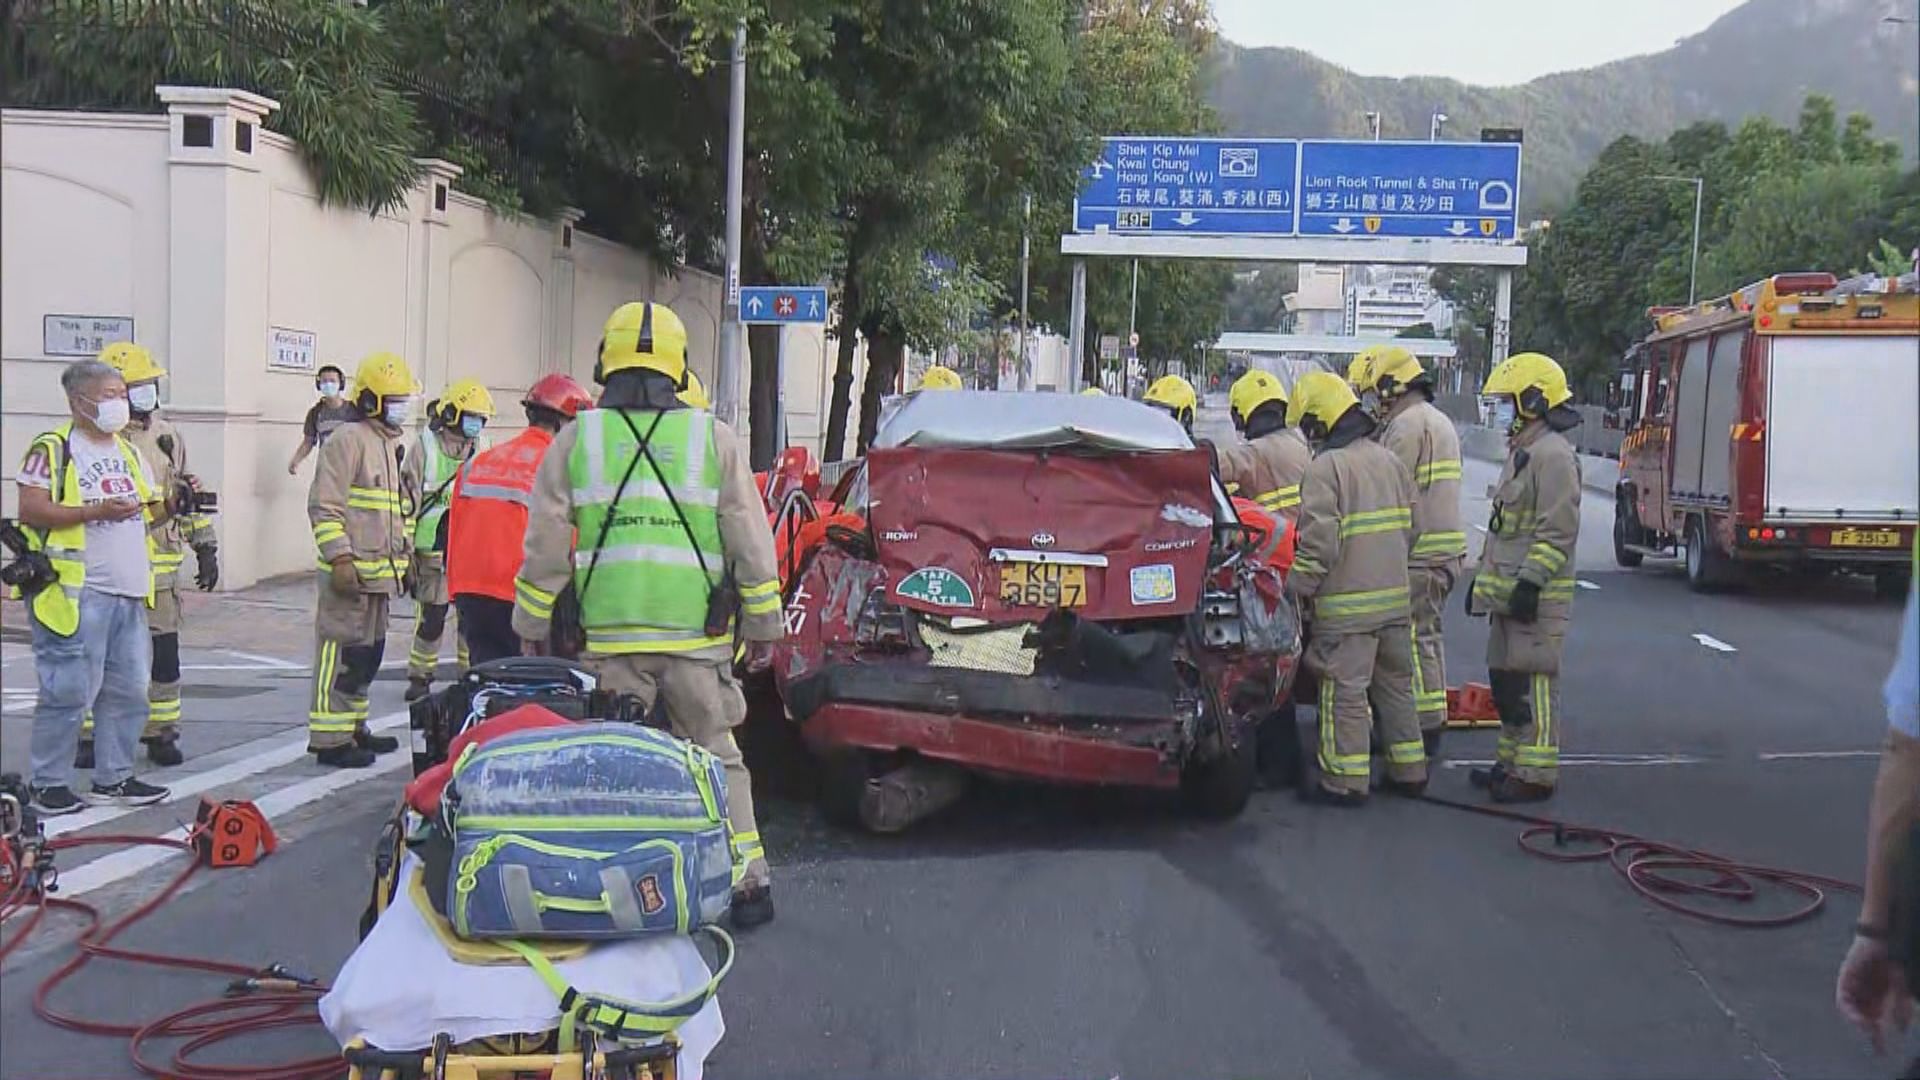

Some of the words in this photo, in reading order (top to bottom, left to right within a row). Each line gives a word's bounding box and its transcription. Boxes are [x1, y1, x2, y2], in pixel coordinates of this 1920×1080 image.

[1118, 145, 1147, 157] Shek
[1153, 145, 1173, 158] Kip
[1178, 146, 1199, 157] Mei
[1117, 157, 1146, 169] Kwai
[1152, 157, 1190, 172] Chung
[1116, 171, 1148, 186] Hong
[1154, 172, 1184, 186] Kong
[1189, 172, 1214, 184] (W)
[1305, 176, 1331, 188] Lion
[1336, 176, 1367, 189] Rock
[1373, 176, 1412, 190] Tunnel
[1417, 177, 1427, 189] &
[1432, 177, 1456, 190] Sha
[1460, 178, 1479, 190] Tin
[1306, 193, 1454, 212] 獅子山隧道及沙田
[879, 532, 918, 541] CROWN
[1841, 533, 1851, 545] F
[1857, 534, 1889, 545] 2513
[1145, 540, 1196, 551] COMFORT
[921, 571, 951, 581] TAXI
[927, 580, 942, 596] 5
[1005, 583, 1080, 607] 3697
